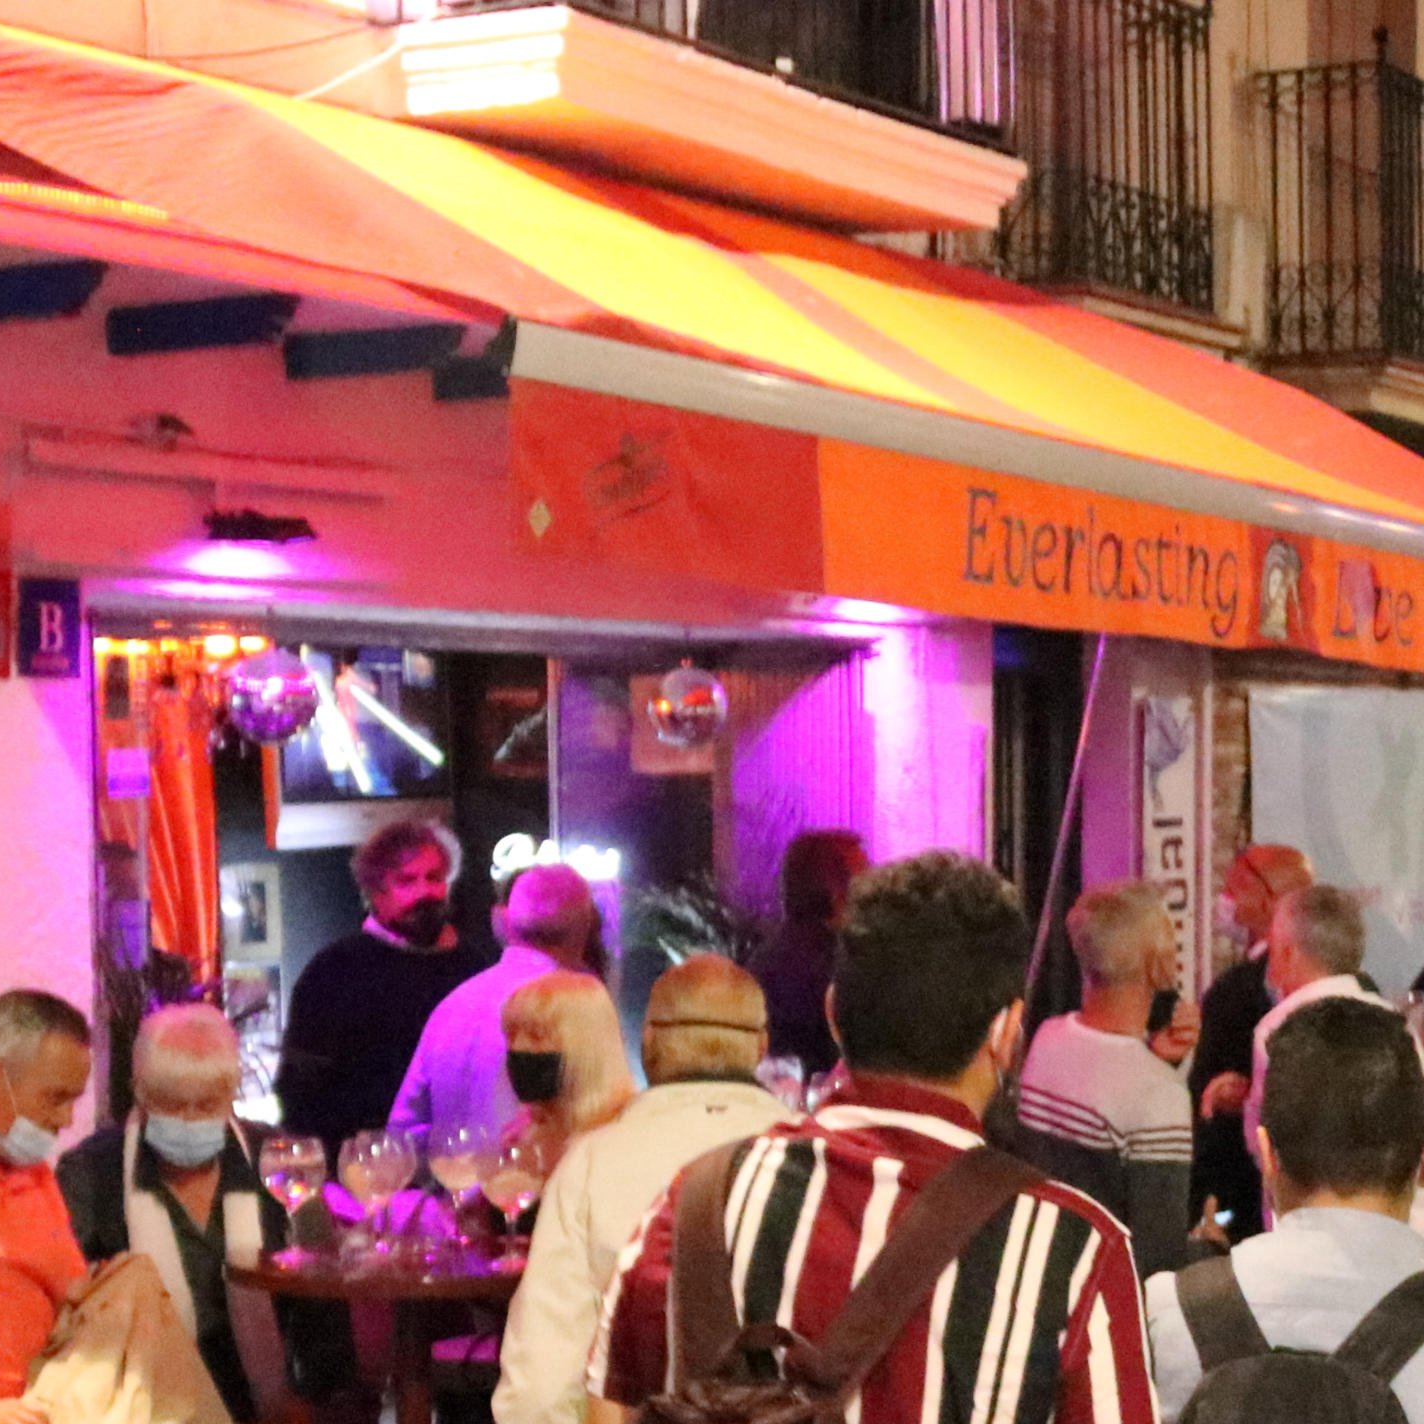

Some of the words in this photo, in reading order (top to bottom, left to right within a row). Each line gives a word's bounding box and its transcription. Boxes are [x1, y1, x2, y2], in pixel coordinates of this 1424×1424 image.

[962, 486, 1240, 641] Everlasting
[1333, 560, 1415, 648] Lve
[39, 602, 64, 653] B
